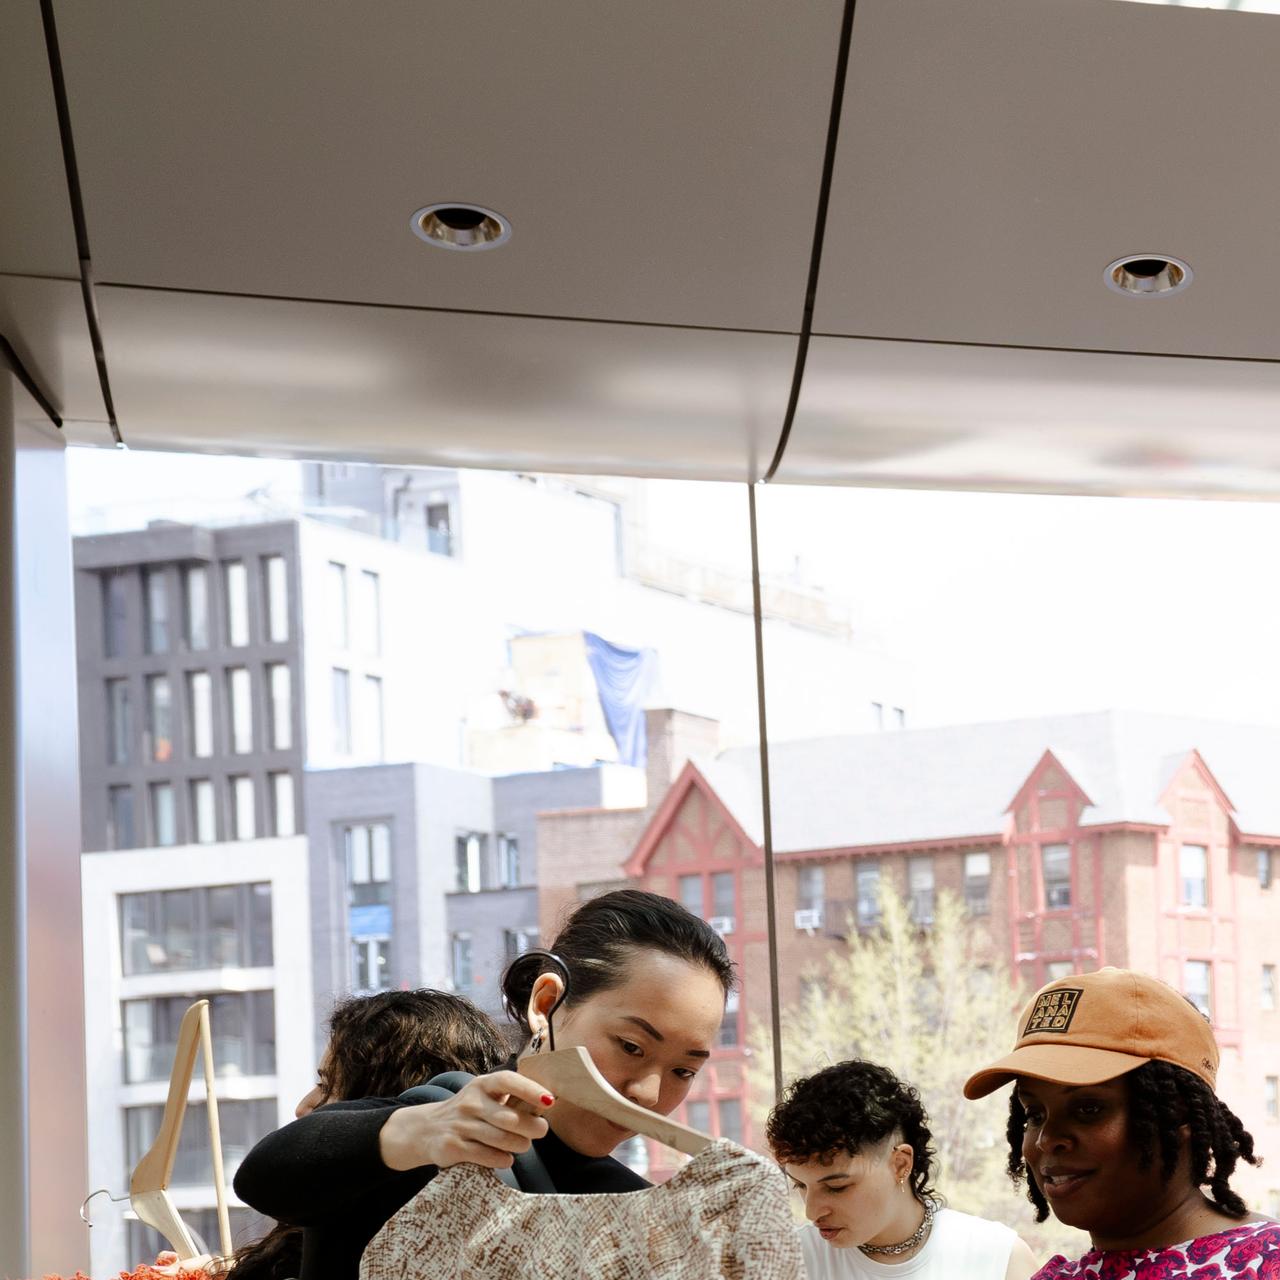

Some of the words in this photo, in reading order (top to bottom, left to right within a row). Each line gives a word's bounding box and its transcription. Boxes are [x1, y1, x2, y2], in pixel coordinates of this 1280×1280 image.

[1038, 993, 1071, 1007] MEL
[1033, 1005, 1069, 1018] ANA
[1031, 1016, 1066, 1029] TED
